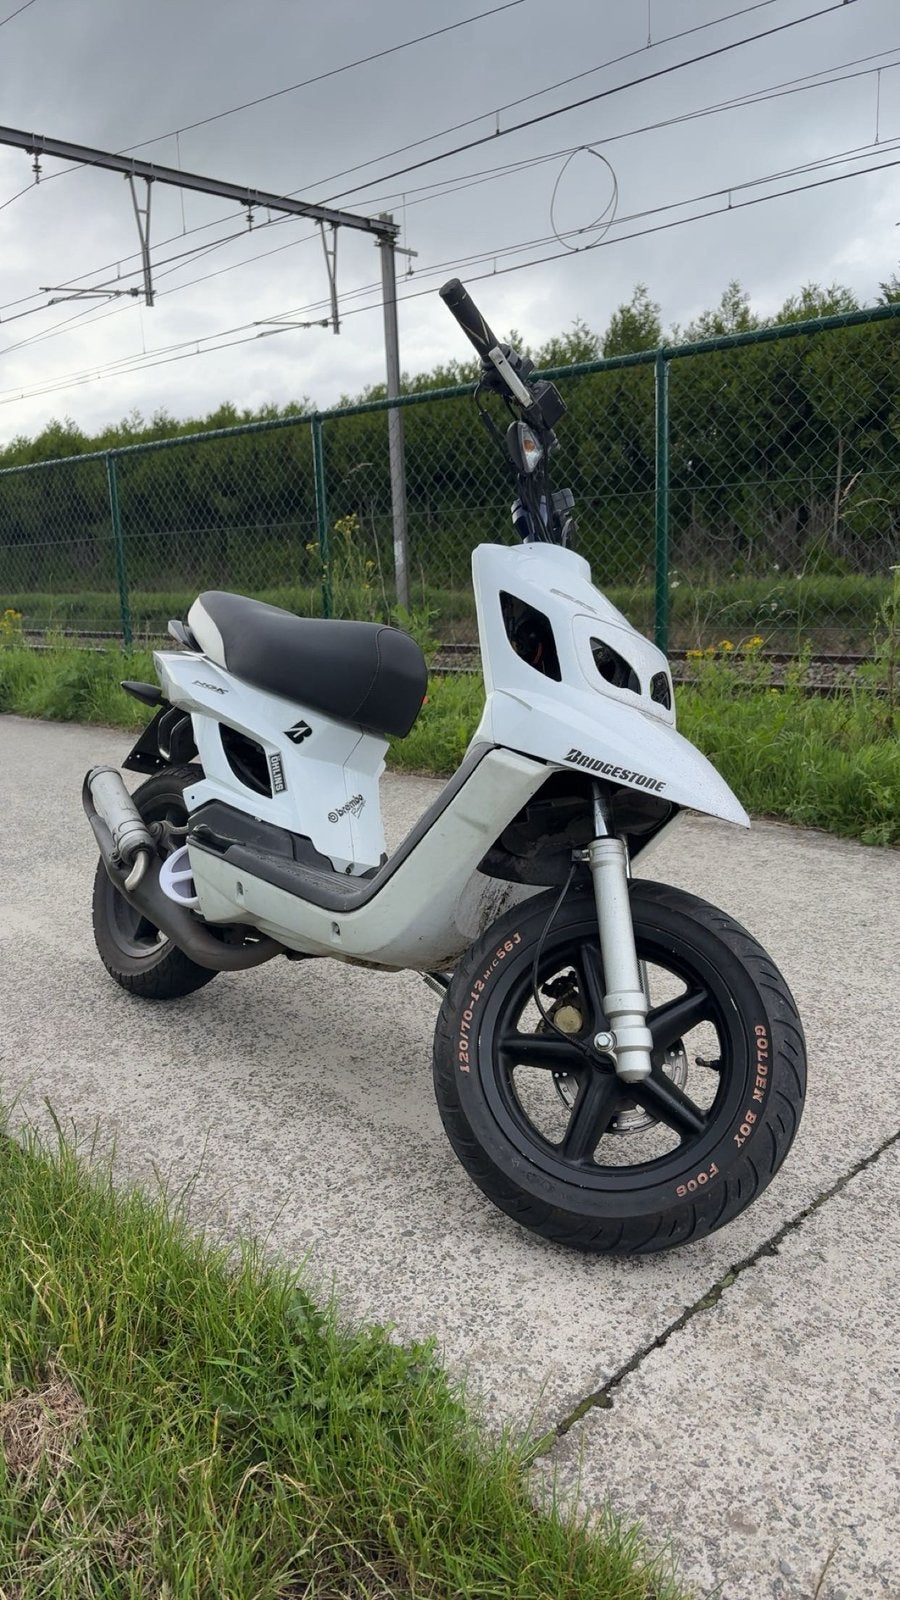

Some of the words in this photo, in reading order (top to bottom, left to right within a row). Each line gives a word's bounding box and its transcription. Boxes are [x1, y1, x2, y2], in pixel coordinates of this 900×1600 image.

[563, 748, 667, 792] BRIDGESTONE
[459, 979, 485, 1073] 120/70-12
[496, 932, 522, 960] 56J
[754, 1025, 769, 1103] GOLDEN
[734, 1110, 757, 1148] BOY
